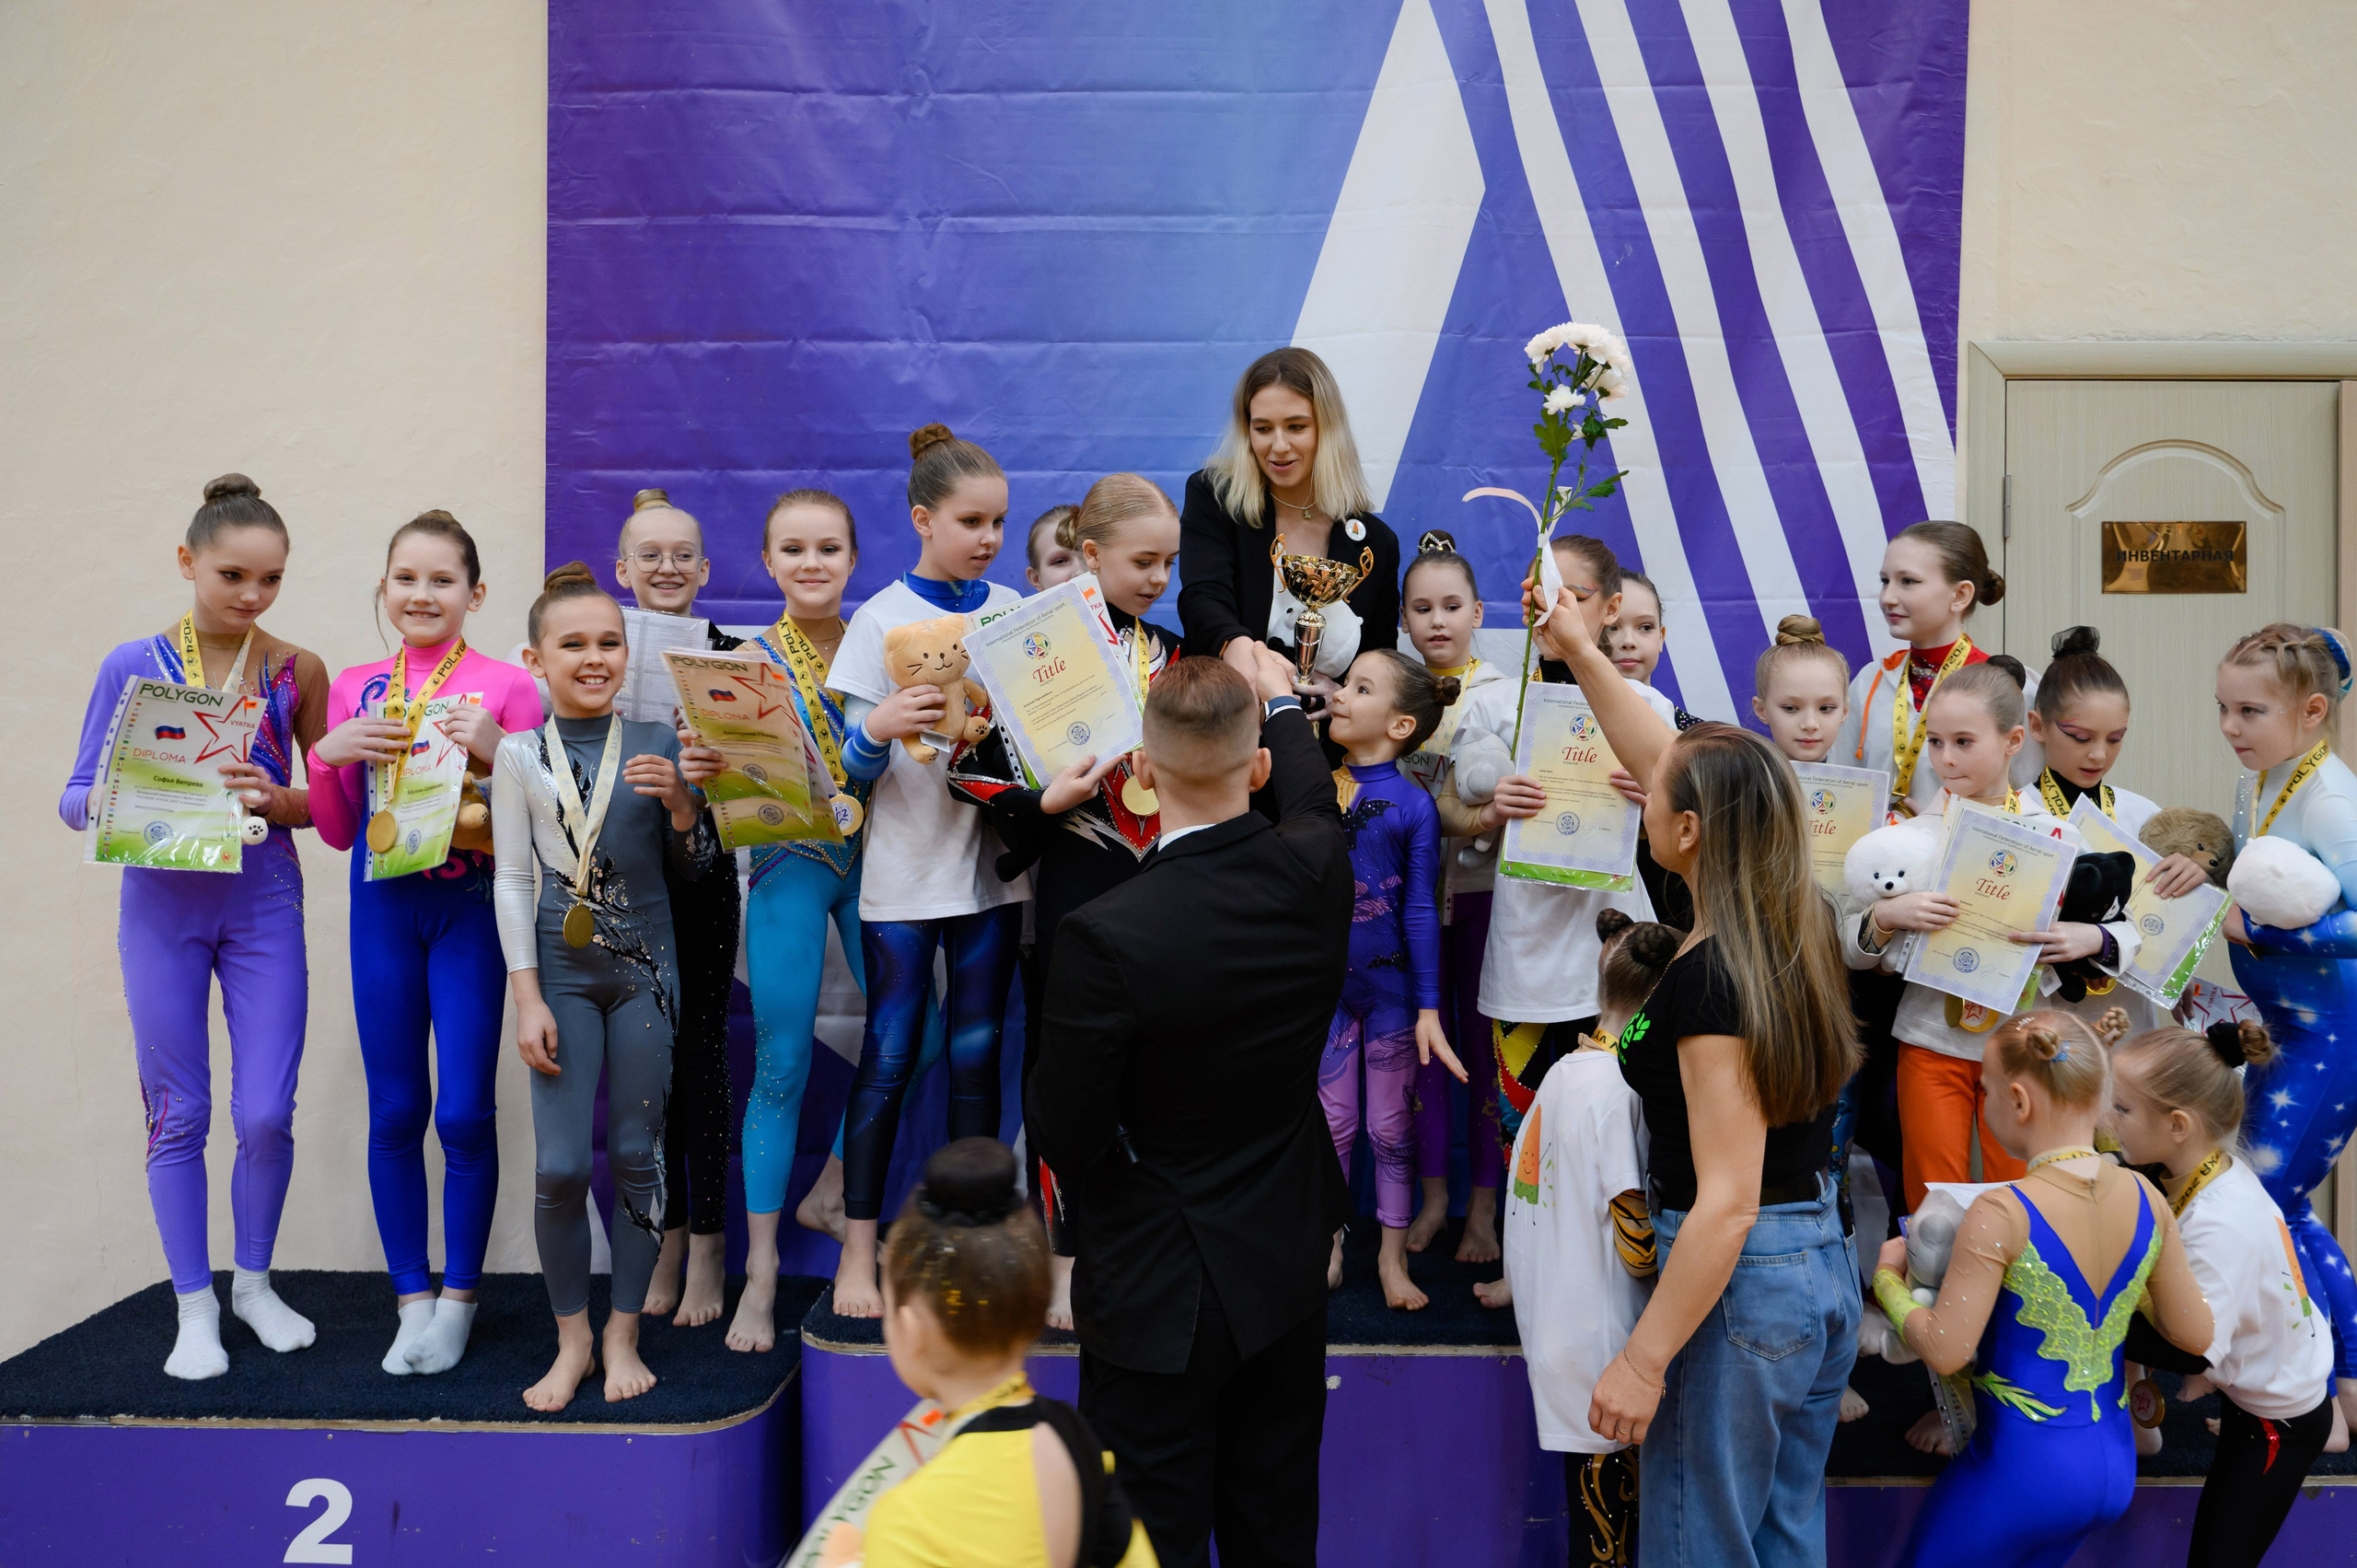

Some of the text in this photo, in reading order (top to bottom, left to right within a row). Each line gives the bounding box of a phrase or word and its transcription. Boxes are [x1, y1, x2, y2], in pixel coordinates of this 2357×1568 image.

[2116, 550, 2234, 562] ИНВЕНТАРНАЯ
[1013, 616, 1036, 633] Federation
[1054, 602, 1065, 612] sport
[183, 617, 193, 653] 2024
[669, 656, 749, 672] POLYGON
[1032, 656, 1066, 683] Title
[139, 683, 224, 707] POLYGON
[701, 708, 750, 721] DIPLOMA
[230, 719, 255, 729] VYATKA
[133, 748, 186, 763] DIPLOMA
[1562, 746, 1597, 763] Title
[153, 774, 203, 787] Софья Вепрева
[1998, 834, 2024, 848] Federation
[1976, 877, 2011, 900] Title
[283, 1478, 353, 1564] 2
